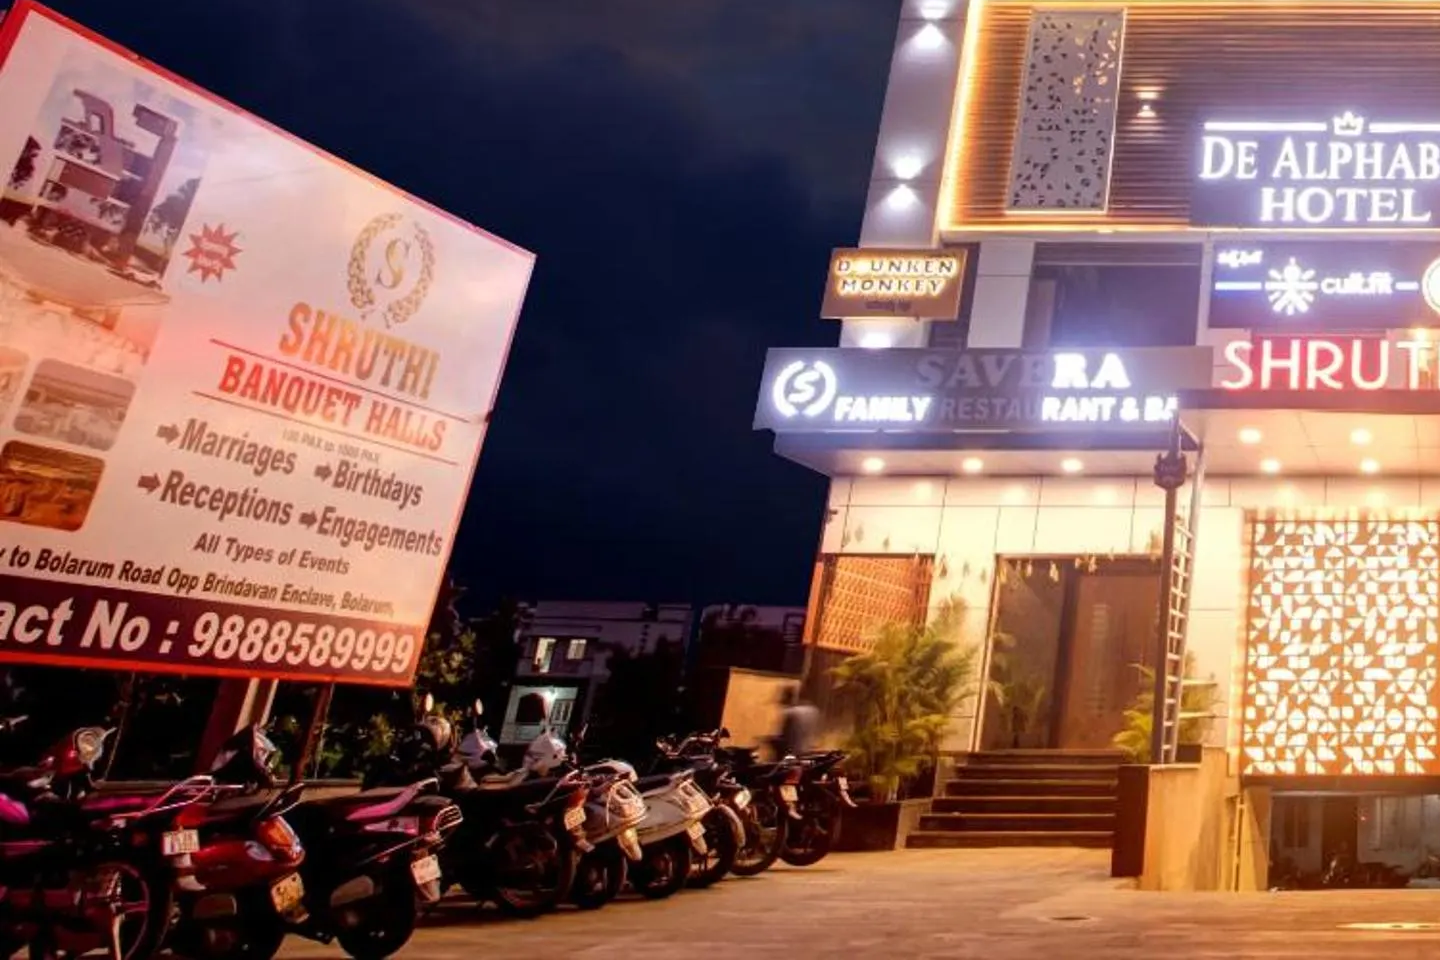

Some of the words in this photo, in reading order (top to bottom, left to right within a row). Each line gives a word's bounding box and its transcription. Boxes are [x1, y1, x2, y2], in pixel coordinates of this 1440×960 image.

[1198, 135, 1259, 180] DE
[1259, 187, 1431, 223] HOTEL
[837, 258, 955, 275] DUNKEN
[840, 278, 943, 293] MONKEY
[279, 301, 441, 401] SHRUTHI
[915, 352, 1132, 389] SAVERA
[218, 354, 363, 423] BANQUET
[363, 400, 448, 452] HALLS
[834, 395, 932, 422] FAMILY
[940, 396, 1116, 422] RESTAURANT
[1119, 395, 1140, 422] &
[178, 417, 298, 477] Marriages
[332, 459, 424, 510] Birthdays
[159, 469, 295, 523] Receptions
[316, 506, 443, 558] Engagements
[9, 545, 31, 568] to
[34, 548, 116, 579] Bolarum
[118, 560, 166, 585] Road
[167, 568, 200, 595] Opp
[202, 572, 279, 601] Brindavan
[193, 532, 221, 554] All
[223, 537, 274, 564] Types
[277, 548, 297, 566] of
[298, 550, 351, 575] Events
[79, 599, 151, 652] No
[187, 611, 415, 674] 9888589999
